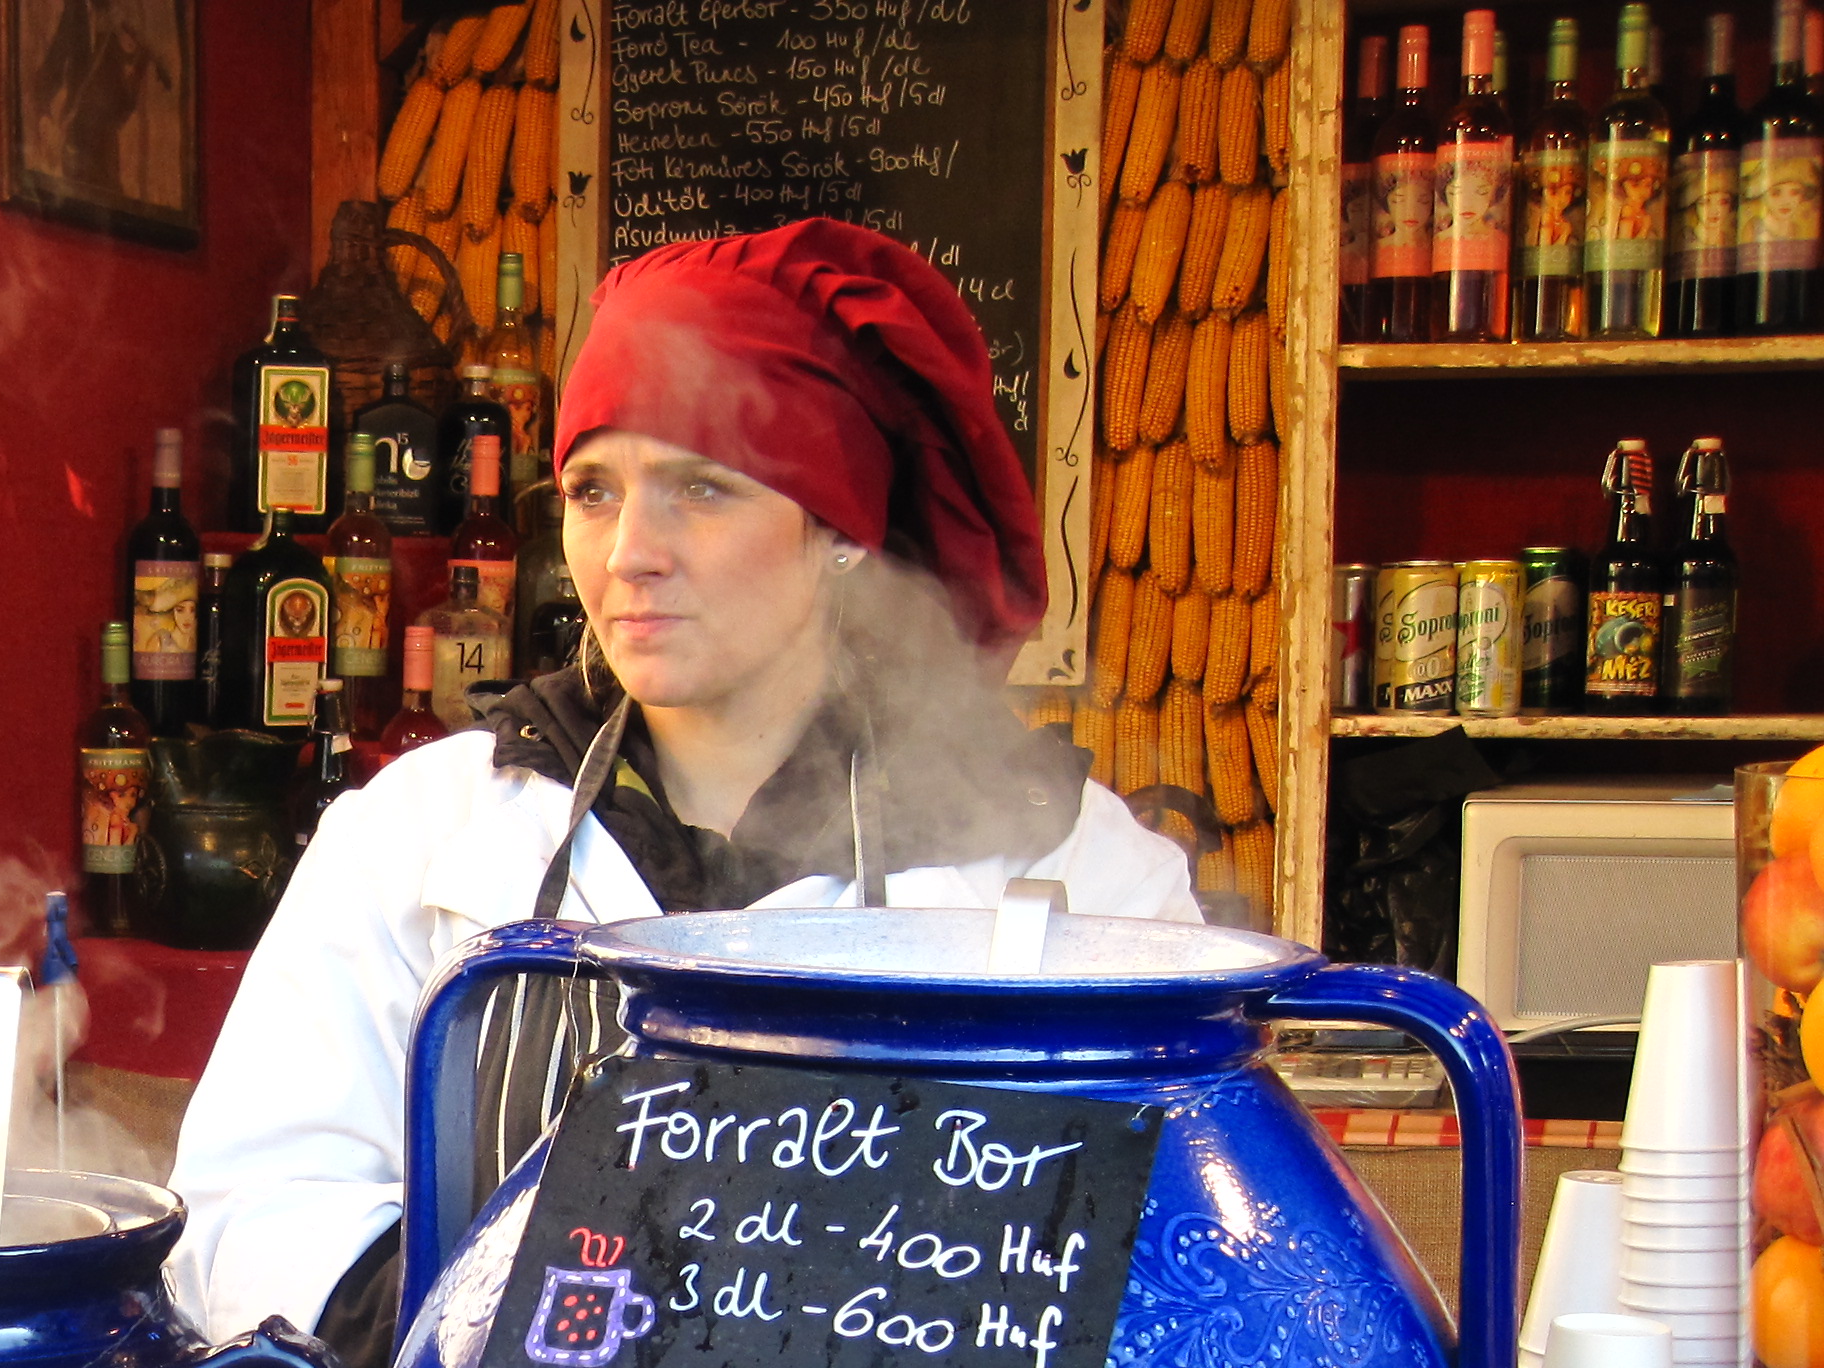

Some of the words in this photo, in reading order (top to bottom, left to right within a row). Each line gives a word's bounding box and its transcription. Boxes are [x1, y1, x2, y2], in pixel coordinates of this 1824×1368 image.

[673, 32, 723, 57] Tea
[777, 28, 817, 50] 100
[612, 59, 687, 93] Gyerek
[689, 60, 758, 85] Puncs
[613, 99, 708, 130] Soproni
[618, 124, 721, 153] Heineken
[396, 432, 410, 445] 15
[456, 642, 484, 674] 14
[615, 1081, 901, 1175] Forralt
[933, 1108, 1083, 1191] Bor
[678, 1198, 717, 1241] 2
[736, 1202, 802, 1246] dl
[999, 1224, 1085, 1292] Huf
[670, 1264, 700, 1312] 3
[713, 1268, 782, 1322] dl
